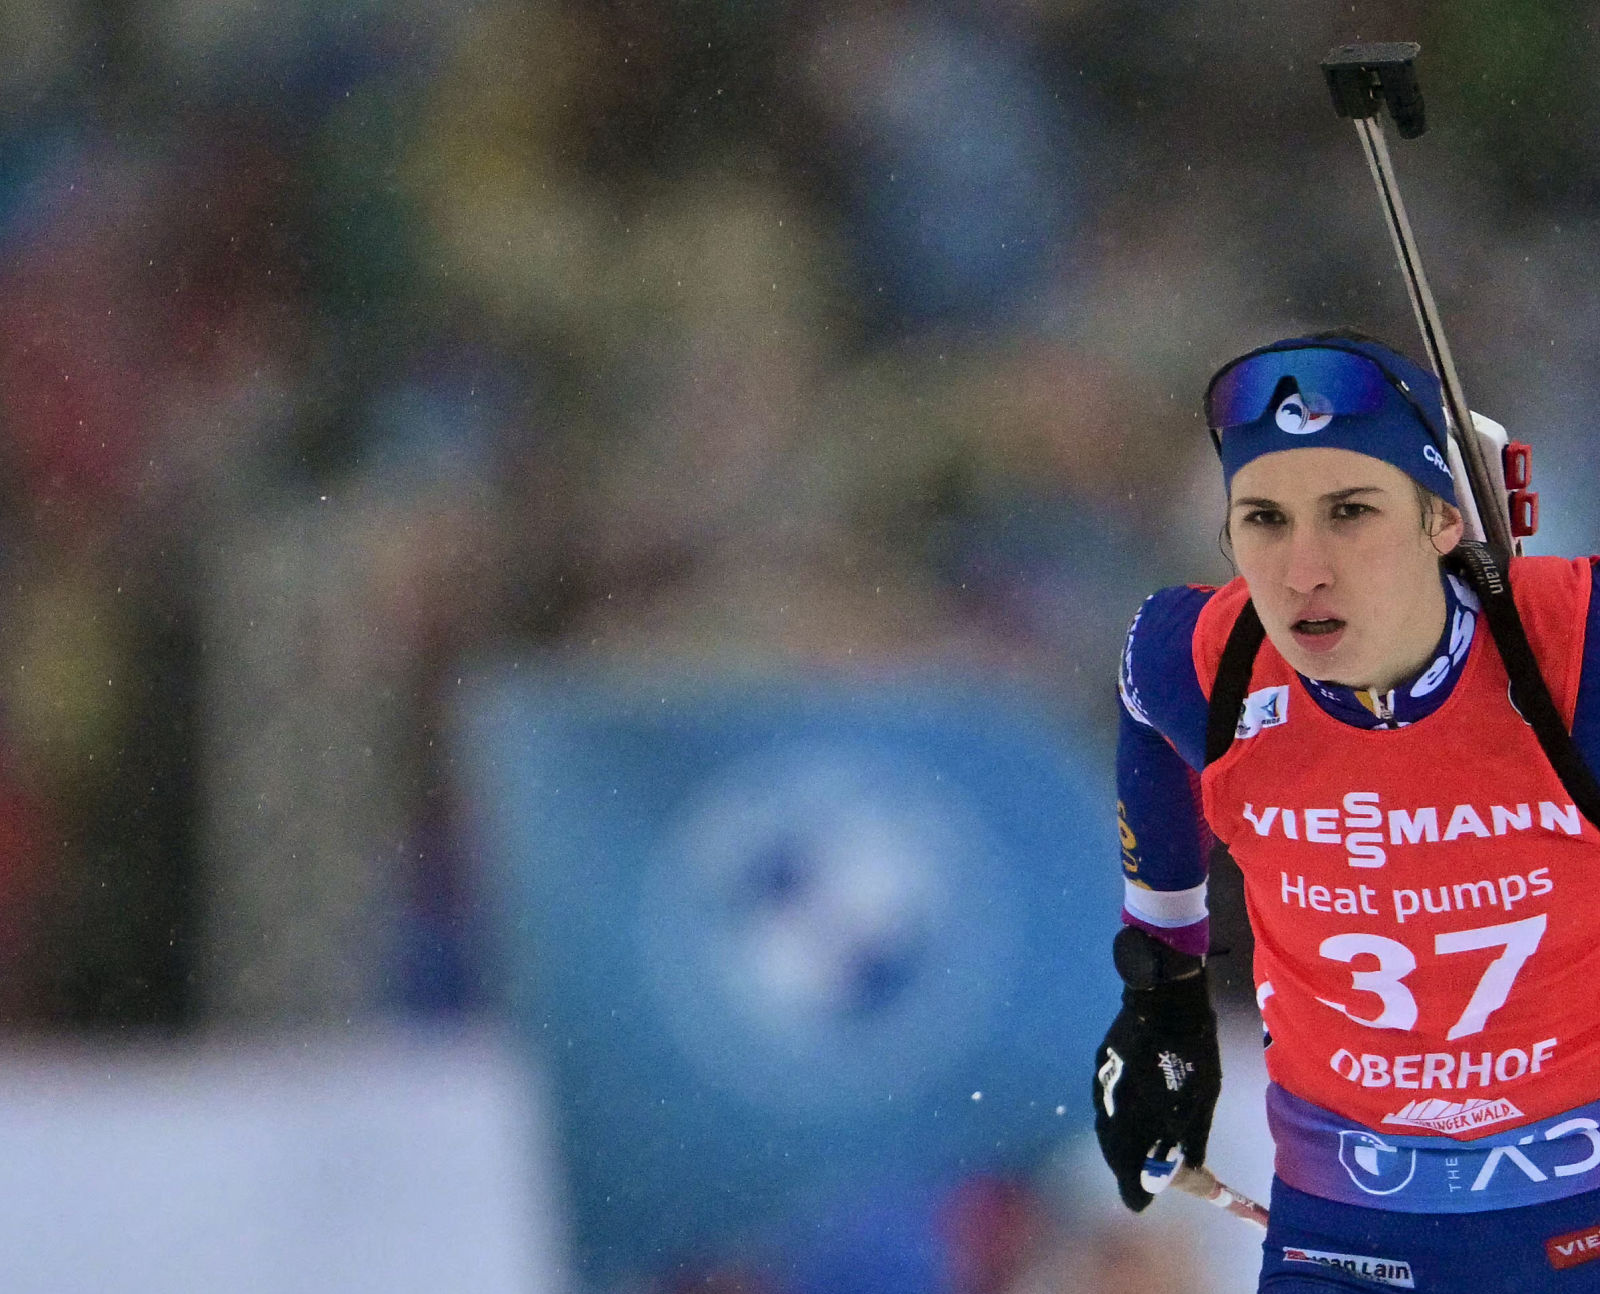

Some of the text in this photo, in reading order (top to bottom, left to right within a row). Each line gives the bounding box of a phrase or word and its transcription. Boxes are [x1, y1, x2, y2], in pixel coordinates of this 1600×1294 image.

[1243, 792, 1582, 868] VIESSMANN
[1281, 867, 1553, 922] Heat pumps
[1314, 913, 1547, 1041] 37
[1330, 1038, 1557, 1088] OBERHOF
[1472, 1103, 1514, 1123] WALD.
[1446, 1157, 1459, 1192] THE
